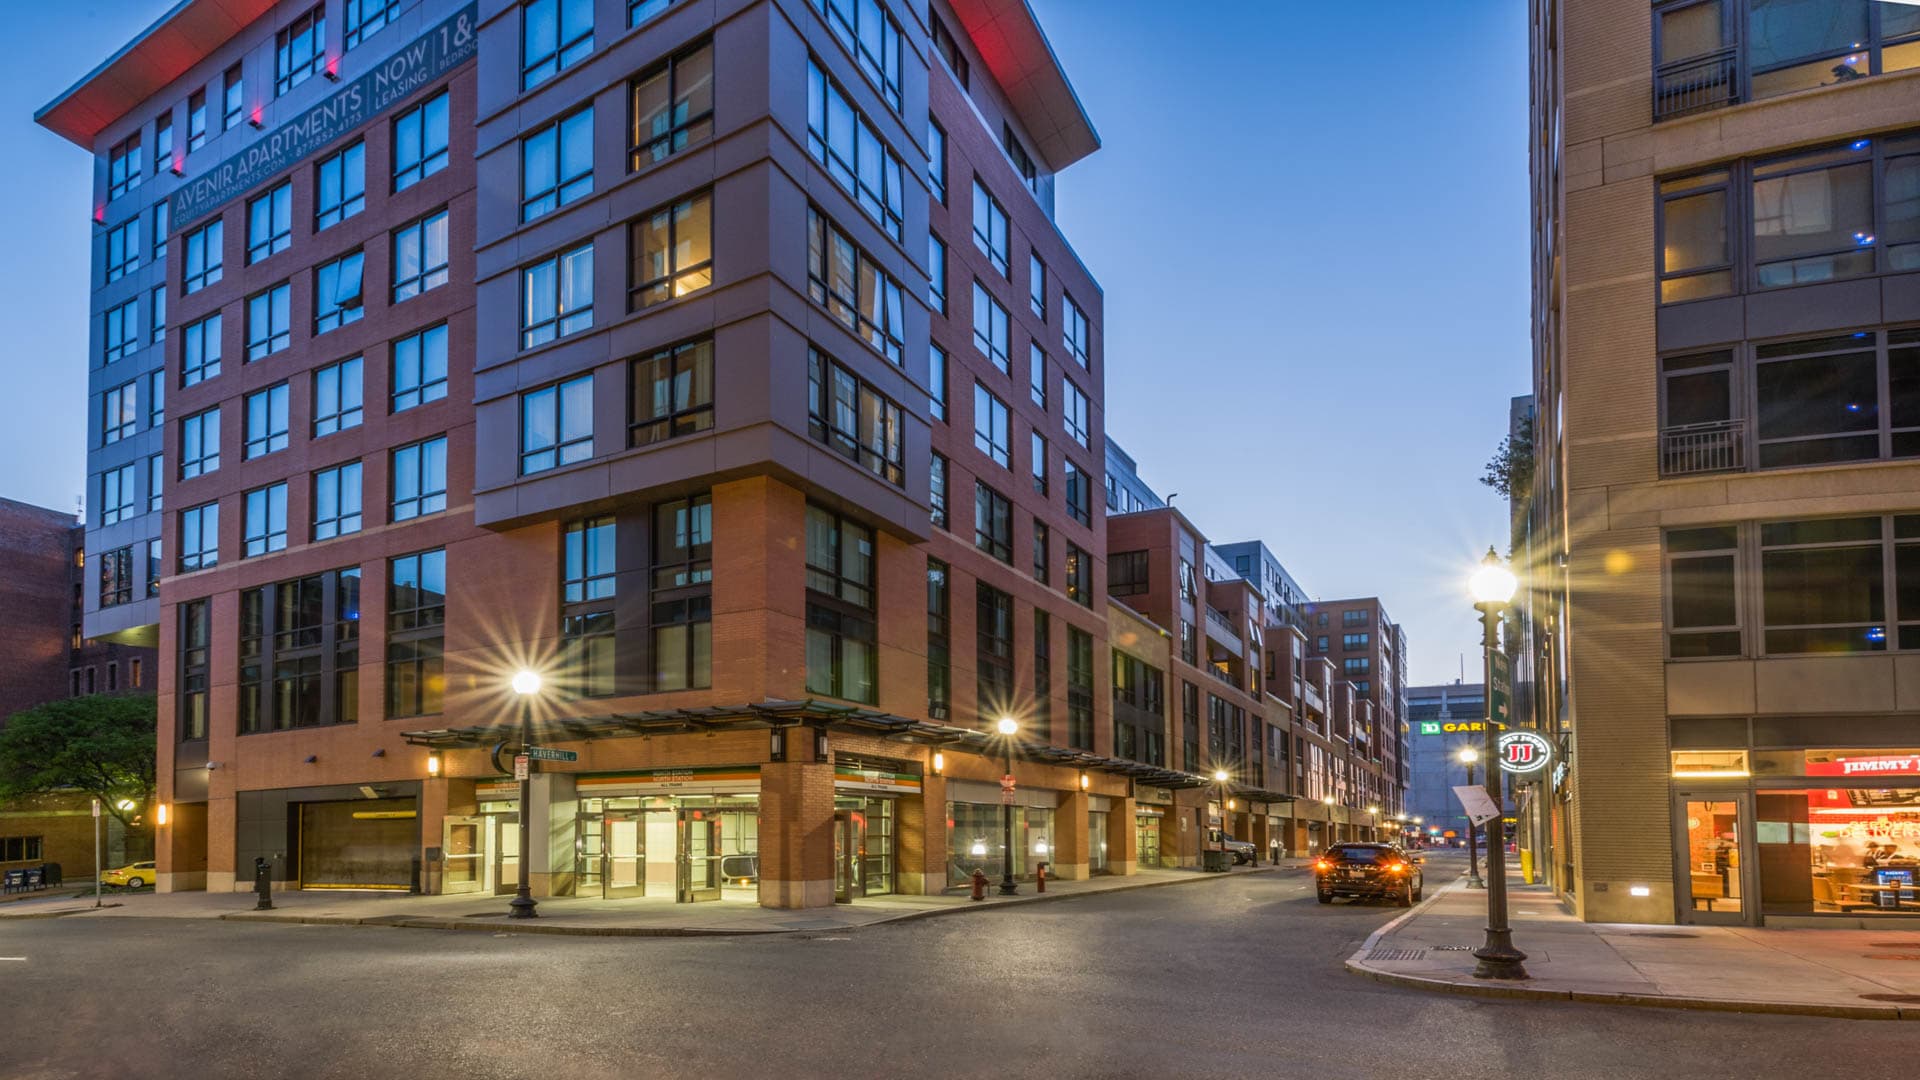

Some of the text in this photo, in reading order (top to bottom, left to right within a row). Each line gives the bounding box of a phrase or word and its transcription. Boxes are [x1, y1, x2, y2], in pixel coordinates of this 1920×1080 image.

[440, 13, 473, 57] 1 &
[375, 39, 427, 93] NOW
[375, 66, 428, 110] LEASING
[176, 84, 362, 213] AVENIR APARTMENTS
[1443, 722, 1506, 731] GAR
[533, 750, 569, 761] HAVERHILL
[1508, 743, 1534, 763] JJ
[1844, 760, 1911, 774] JIMMY
